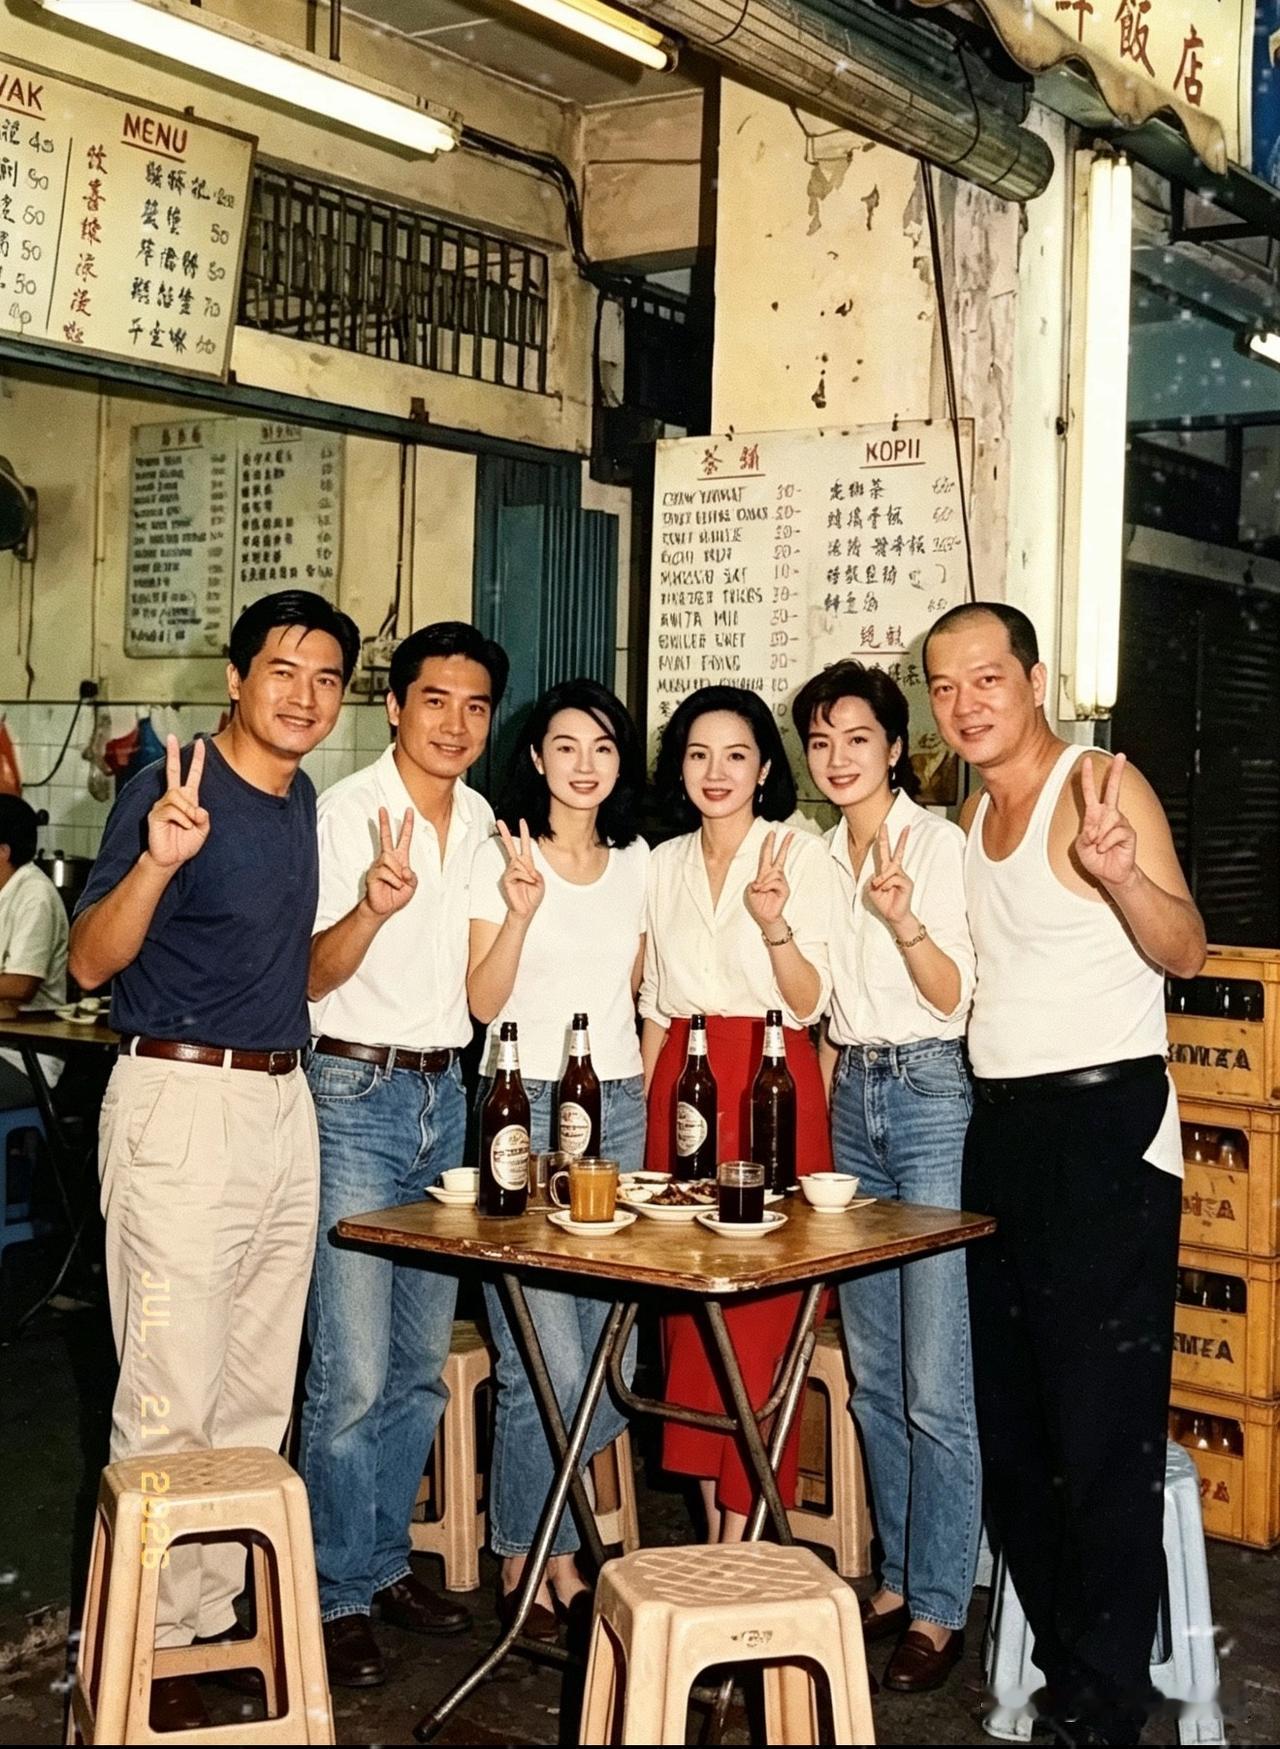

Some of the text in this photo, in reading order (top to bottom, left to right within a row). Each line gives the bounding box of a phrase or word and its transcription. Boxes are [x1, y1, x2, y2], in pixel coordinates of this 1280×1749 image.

[123, 112, 188, 154] MENU
[21, 240, 42, 261] 50
[14, 273, 37, 295] 50
[866, 438, 921, 463] KOPII
